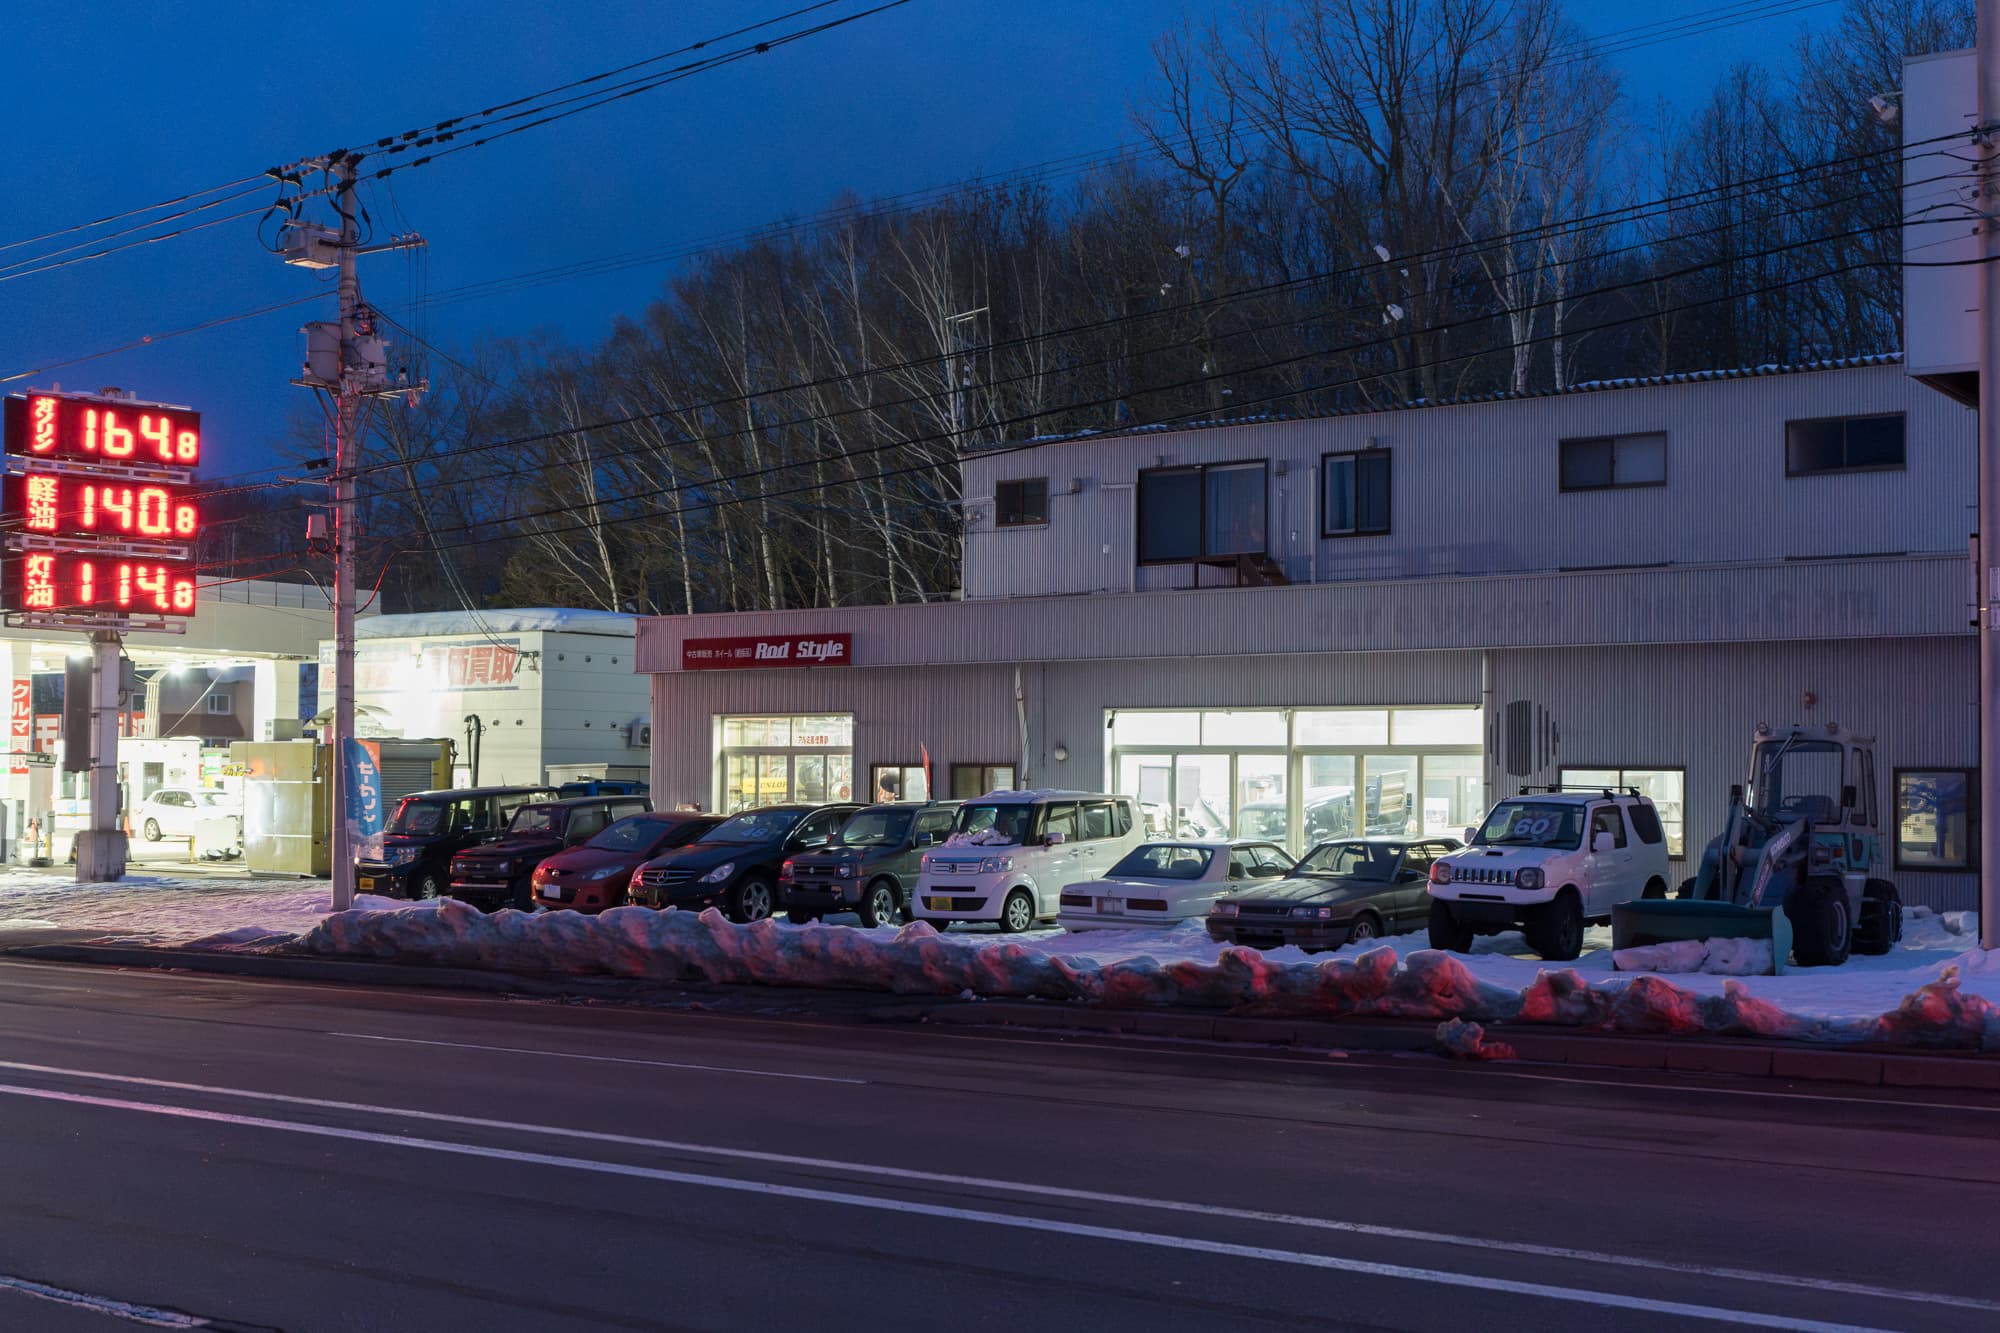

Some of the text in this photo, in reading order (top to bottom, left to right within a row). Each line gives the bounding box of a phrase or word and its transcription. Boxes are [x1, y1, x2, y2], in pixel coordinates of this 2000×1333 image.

[28, 476, 57, 530] 軽油
[26, 554, 54, 607] 灯油
[755, 642, 789, 659] Rod
[796, 640, 843, 661] Style
[1514, 817, 1550, 835] 60
